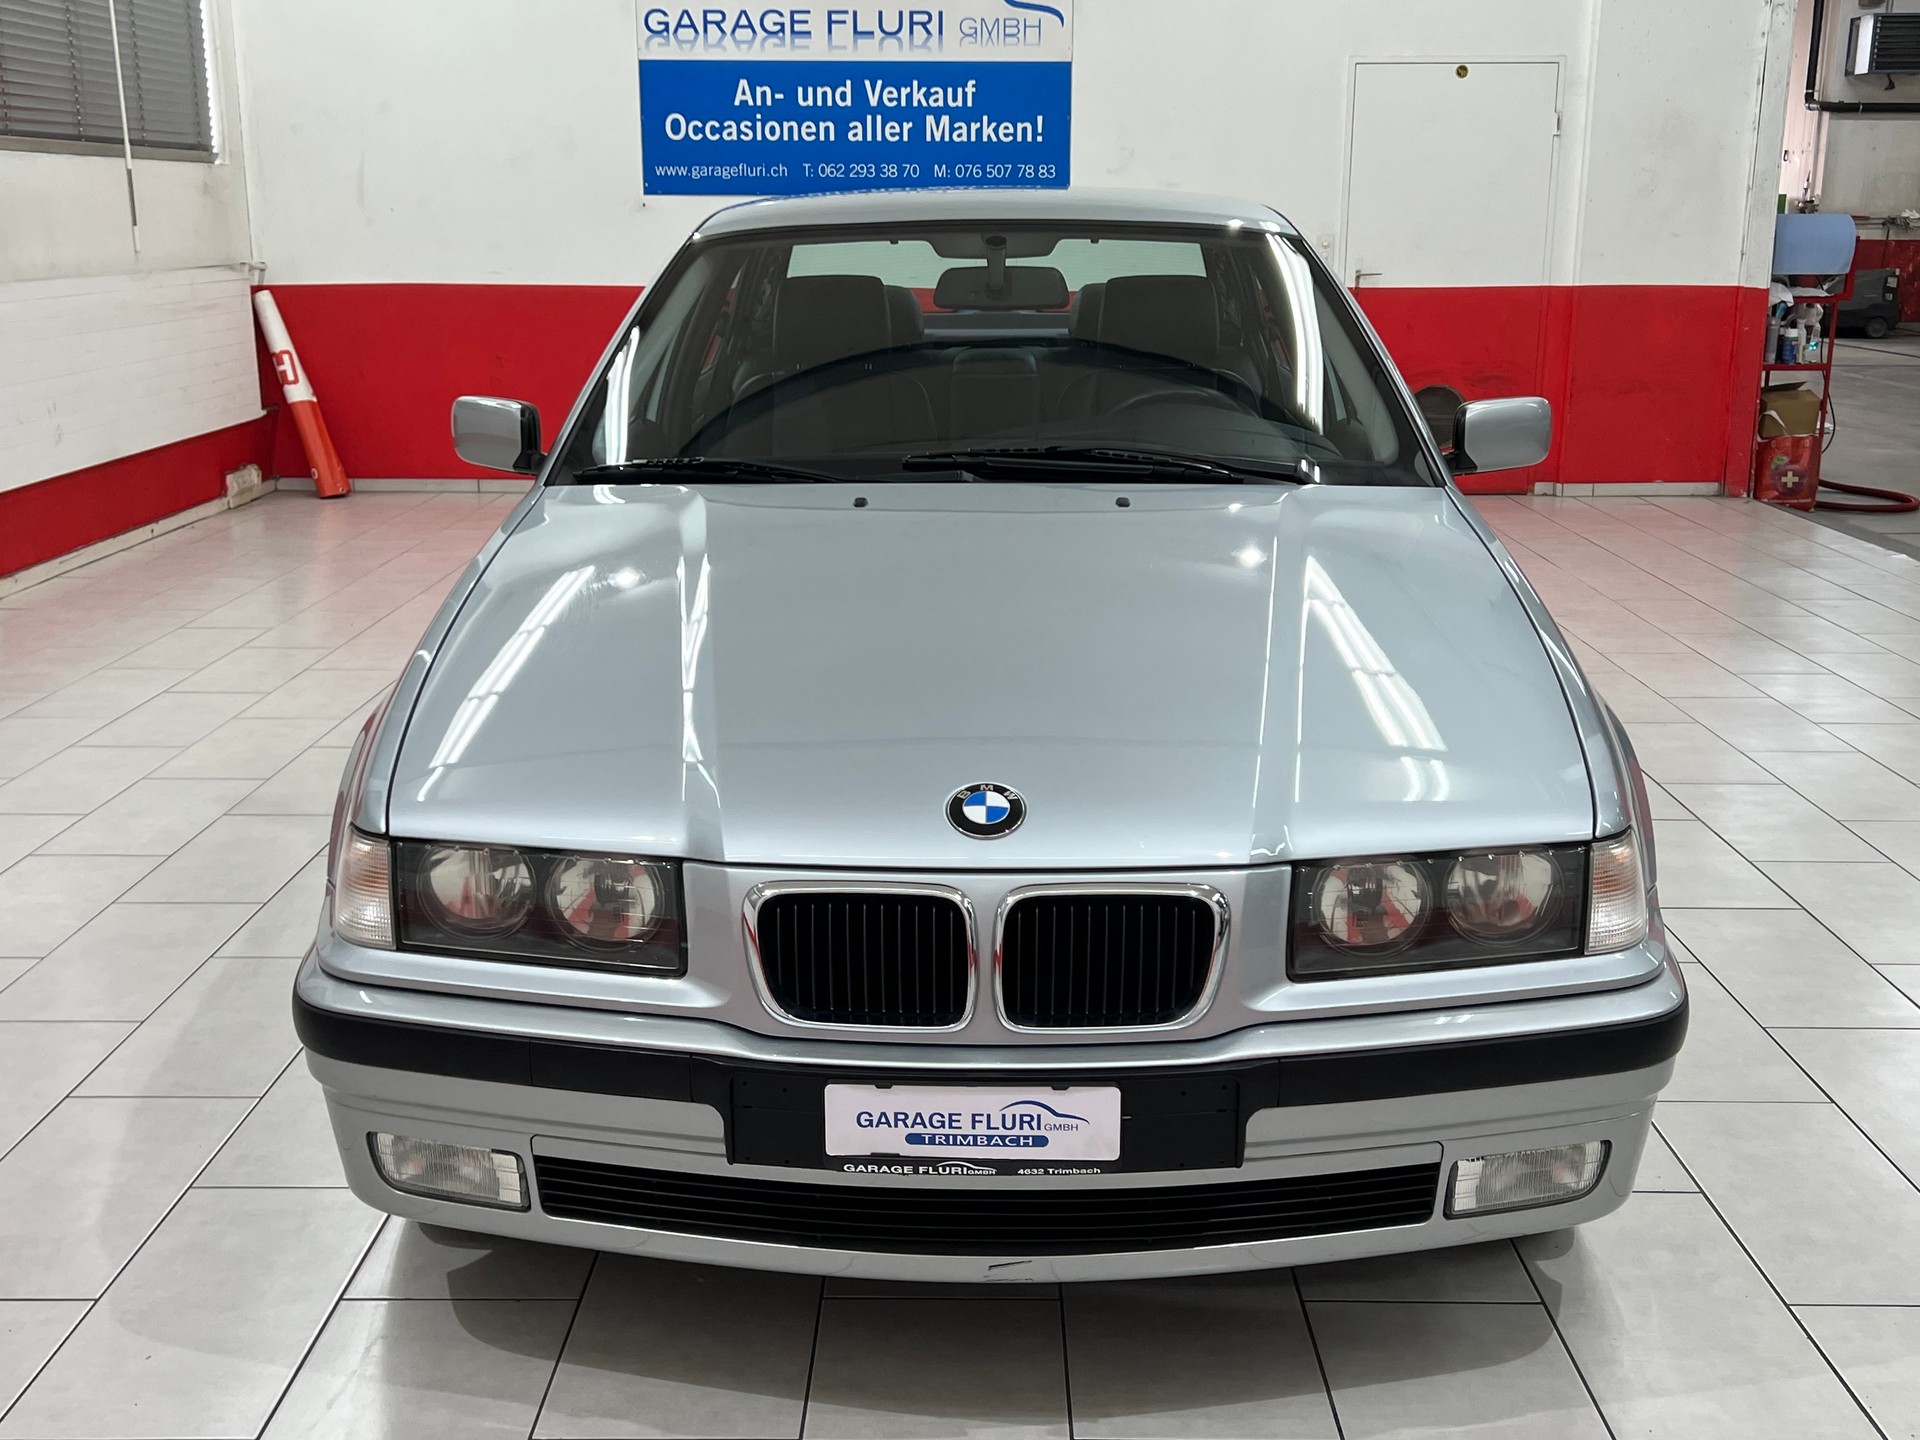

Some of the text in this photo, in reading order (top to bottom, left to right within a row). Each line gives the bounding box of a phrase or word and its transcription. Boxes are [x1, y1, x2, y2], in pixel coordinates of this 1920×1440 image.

[643, 9, 1042, 38] GARAGE FLURI GMBH
[733, 79, 976, 107] An- und Verkauf
[664, 113, 1044, 142] Occasionen aller Marken!
[654, 163, 1055, 180] www.garagefluri.ch T: 062 293 38 70 M: 076 507 78 83
[957, 784, 1018, 800] BMW
[856, 1111, 1078, 1131] GARAGE FLURI GMBH
[922, 1134, 1032, 1146] TRIMBACH
[844, 1164, 913, 1174] GARAGE
[919, 1166, 967, 1174] FLURI
